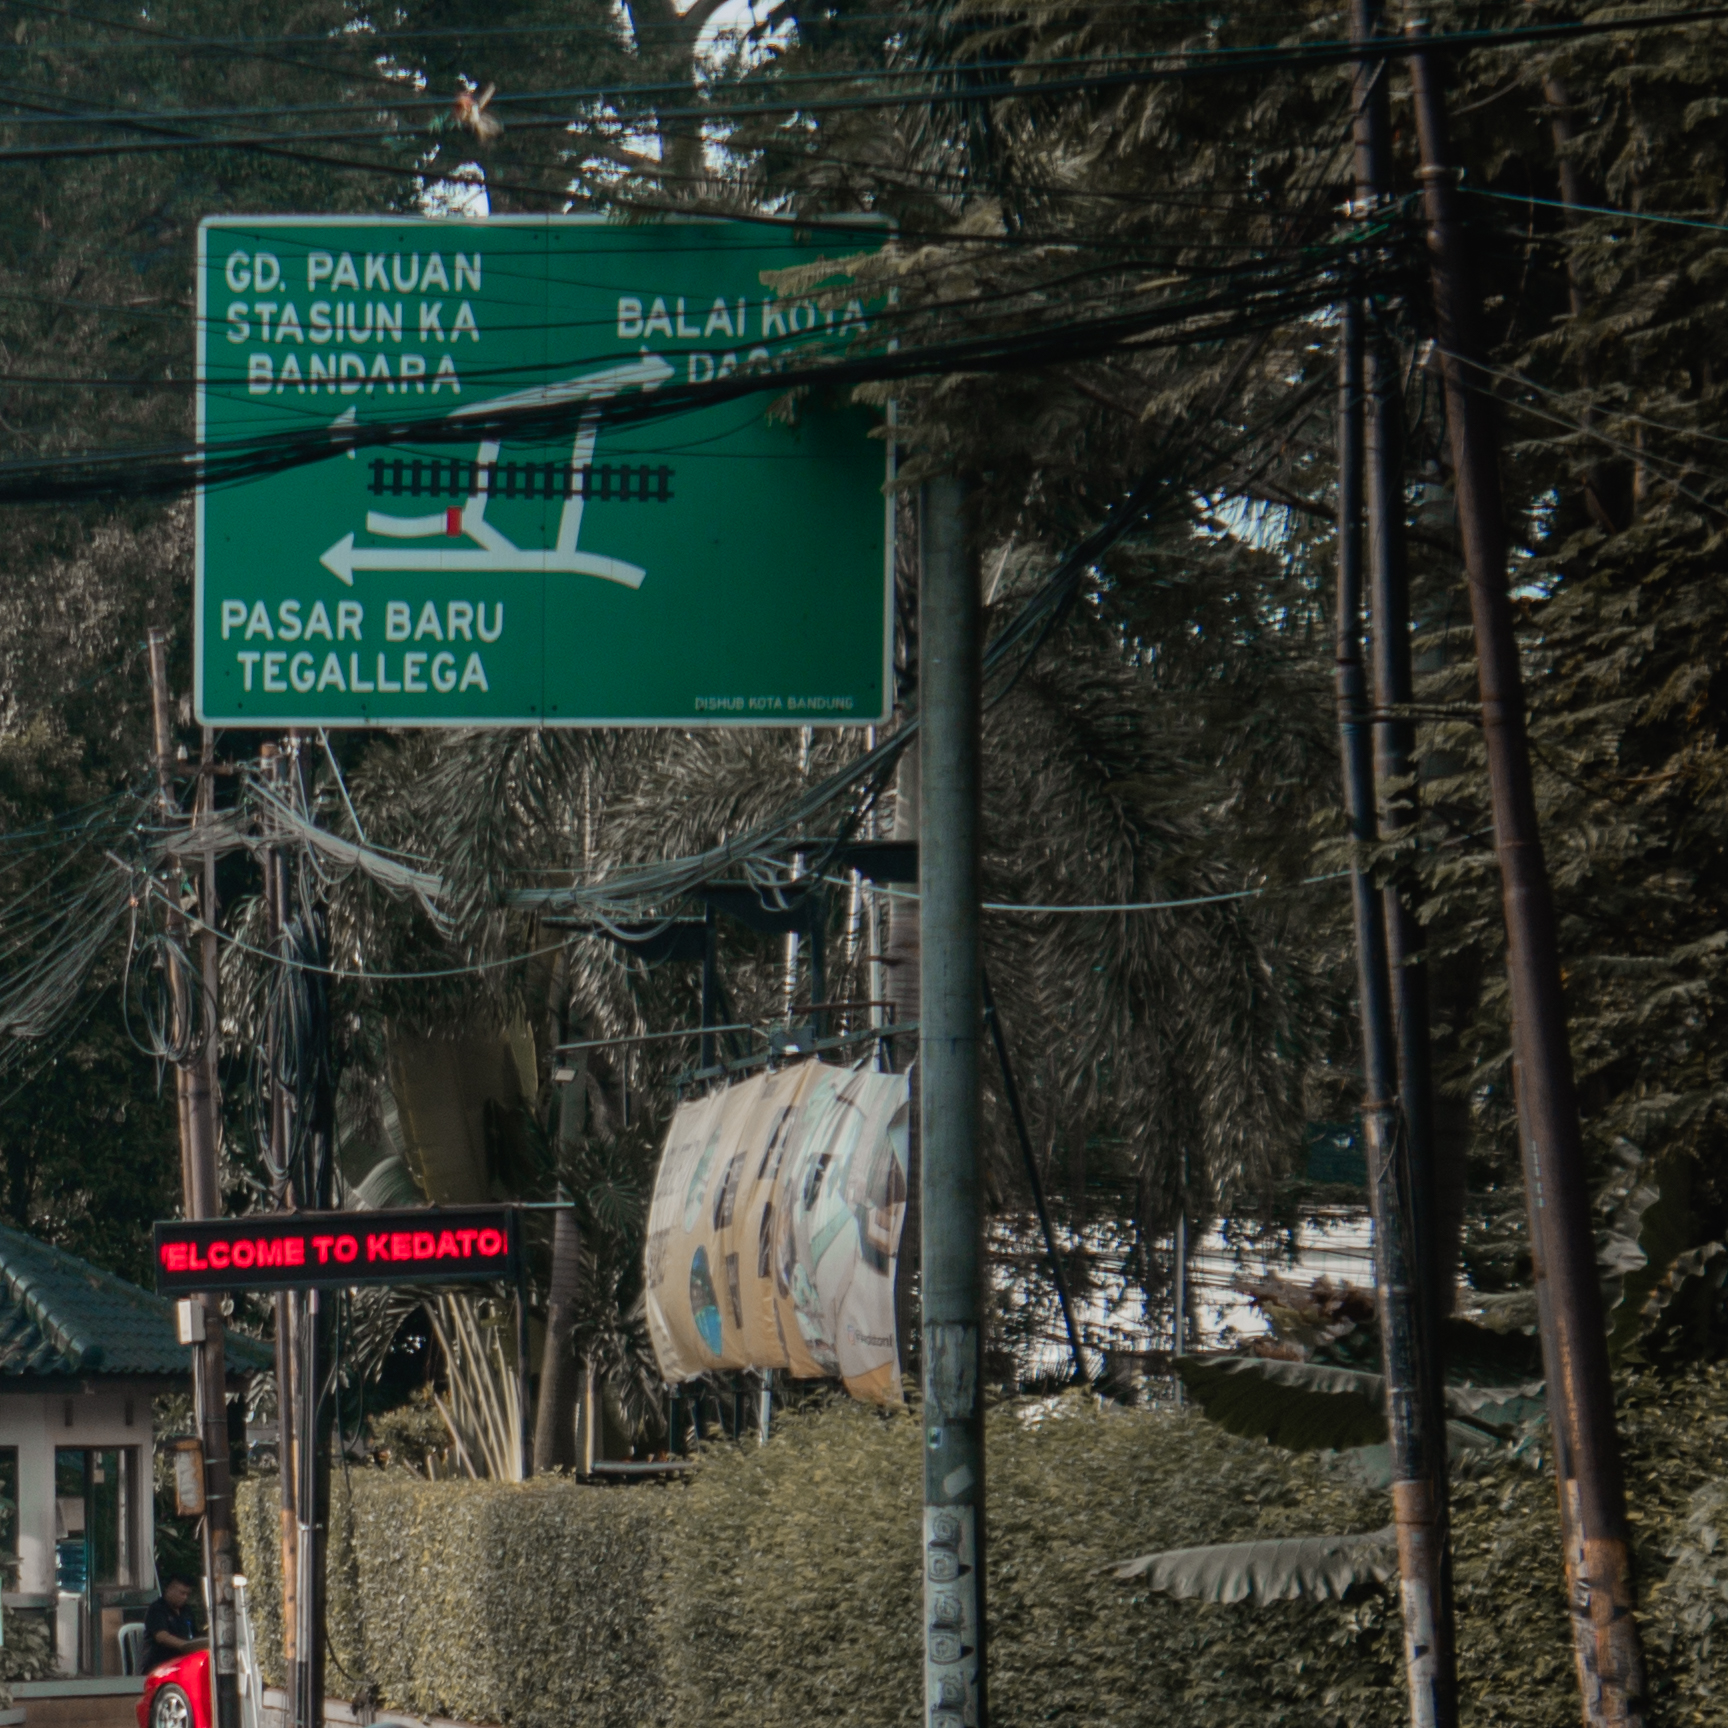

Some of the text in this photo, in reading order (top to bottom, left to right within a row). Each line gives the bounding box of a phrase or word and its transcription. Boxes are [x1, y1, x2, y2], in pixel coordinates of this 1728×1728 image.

[224, 250, 482, 293] GD. PAKUAN
[225, 300, 480, 344] STASIUN KA
[616, 296, 745, 338] BALAI
[247, 352, 462, 395] BANDARA
[221, 599, 504, 643] PASAR BARU
[237, 651, 489, 693] TEGALLEGA
[695, 696, 854, 711] DISHUB KOTA BANDUNG
[312, 1234, 358, 1264] TO
[367, 1228, 508, 1262] KEDATO
